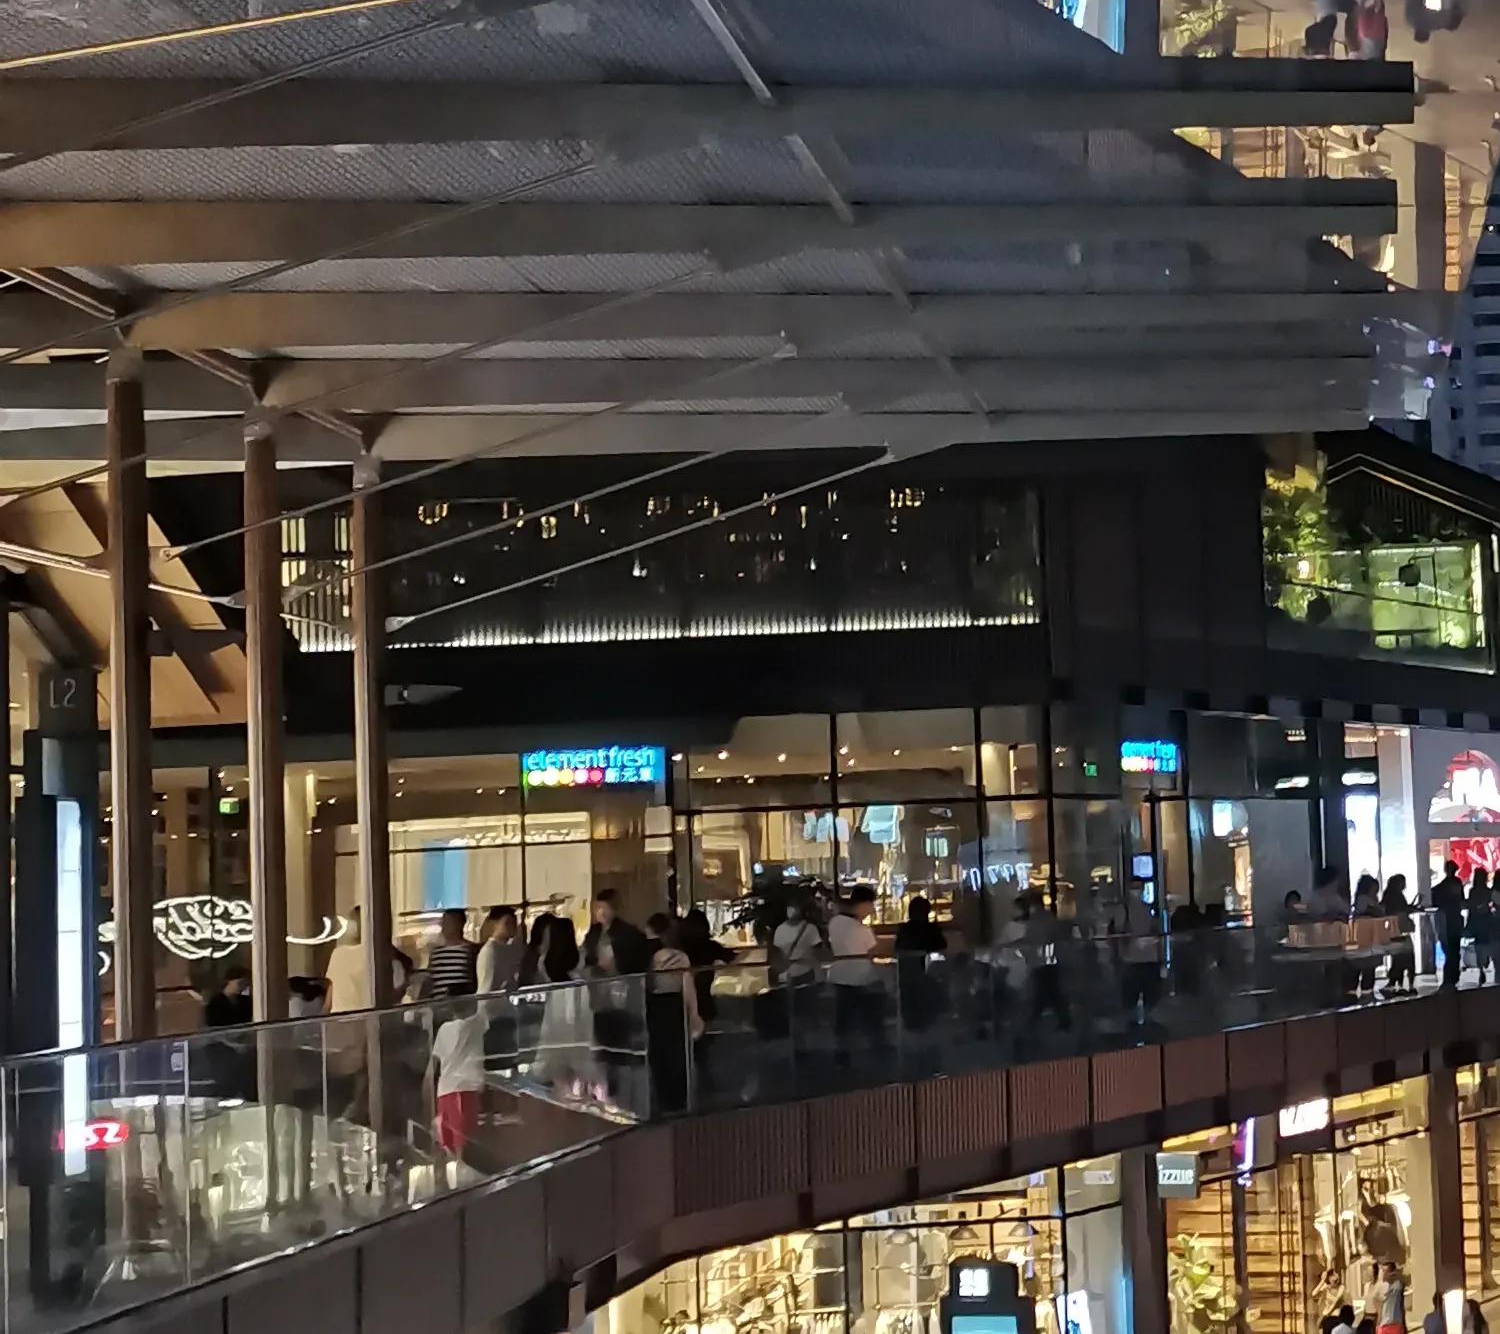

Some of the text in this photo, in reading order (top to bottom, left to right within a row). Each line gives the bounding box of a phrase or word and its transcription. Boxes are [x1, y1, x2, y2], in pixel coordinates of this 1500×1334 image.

[50, 678, 77, 708] L2
[527, 745, 656, 770] element fresh
